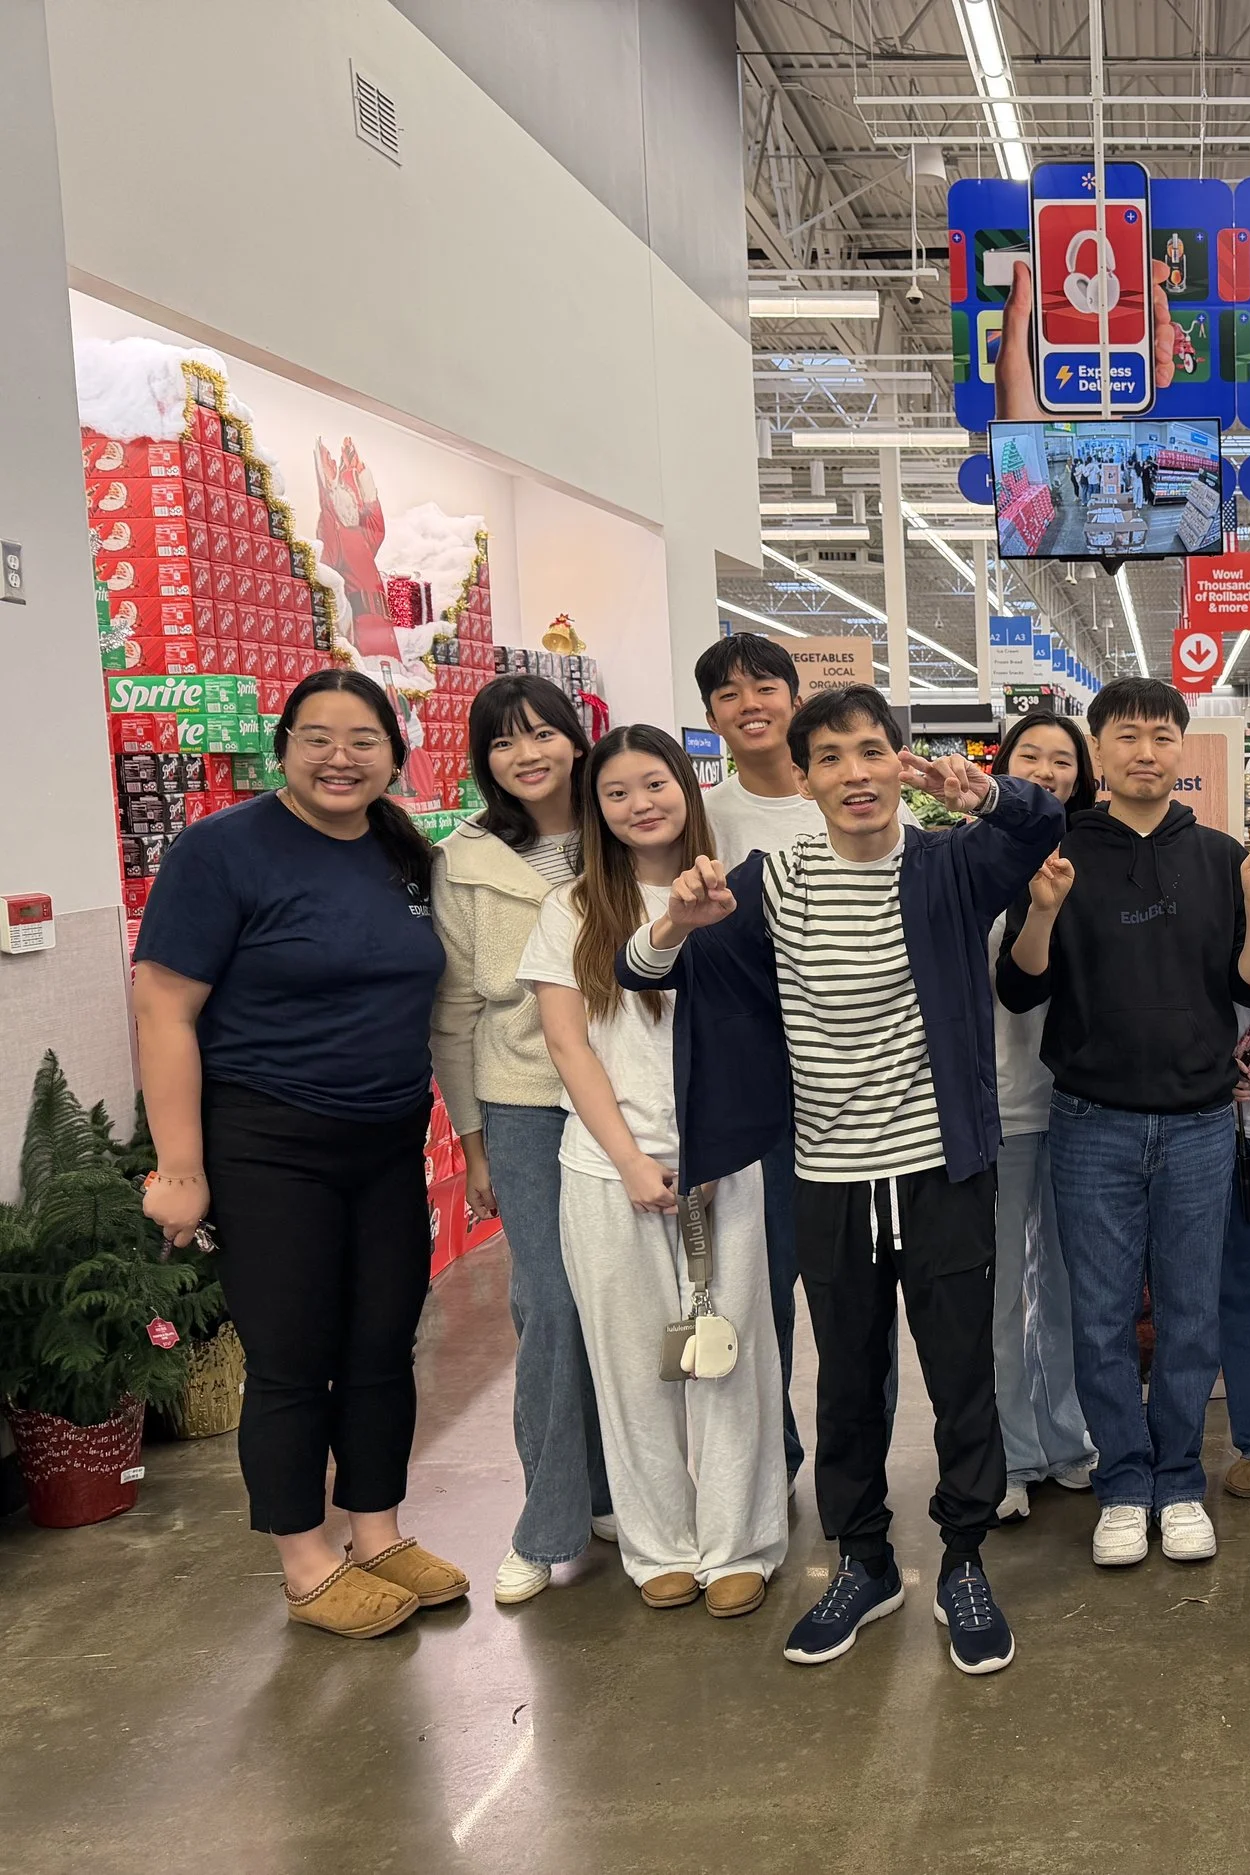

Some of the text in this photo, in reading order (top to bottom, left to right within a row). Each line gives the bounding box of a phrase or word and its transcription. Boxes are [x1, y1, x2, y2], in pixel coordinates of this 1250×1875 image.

[1078, 365, 1132, 379] Expess
[1212, 569, 1243, 580] Wow!
[1195, 591, 1207, 601] of
[1208, 603, 1248, 612] & more
[823, 667, 855, 676] LOCAL
[111, 678, 202, 713] Sprite
